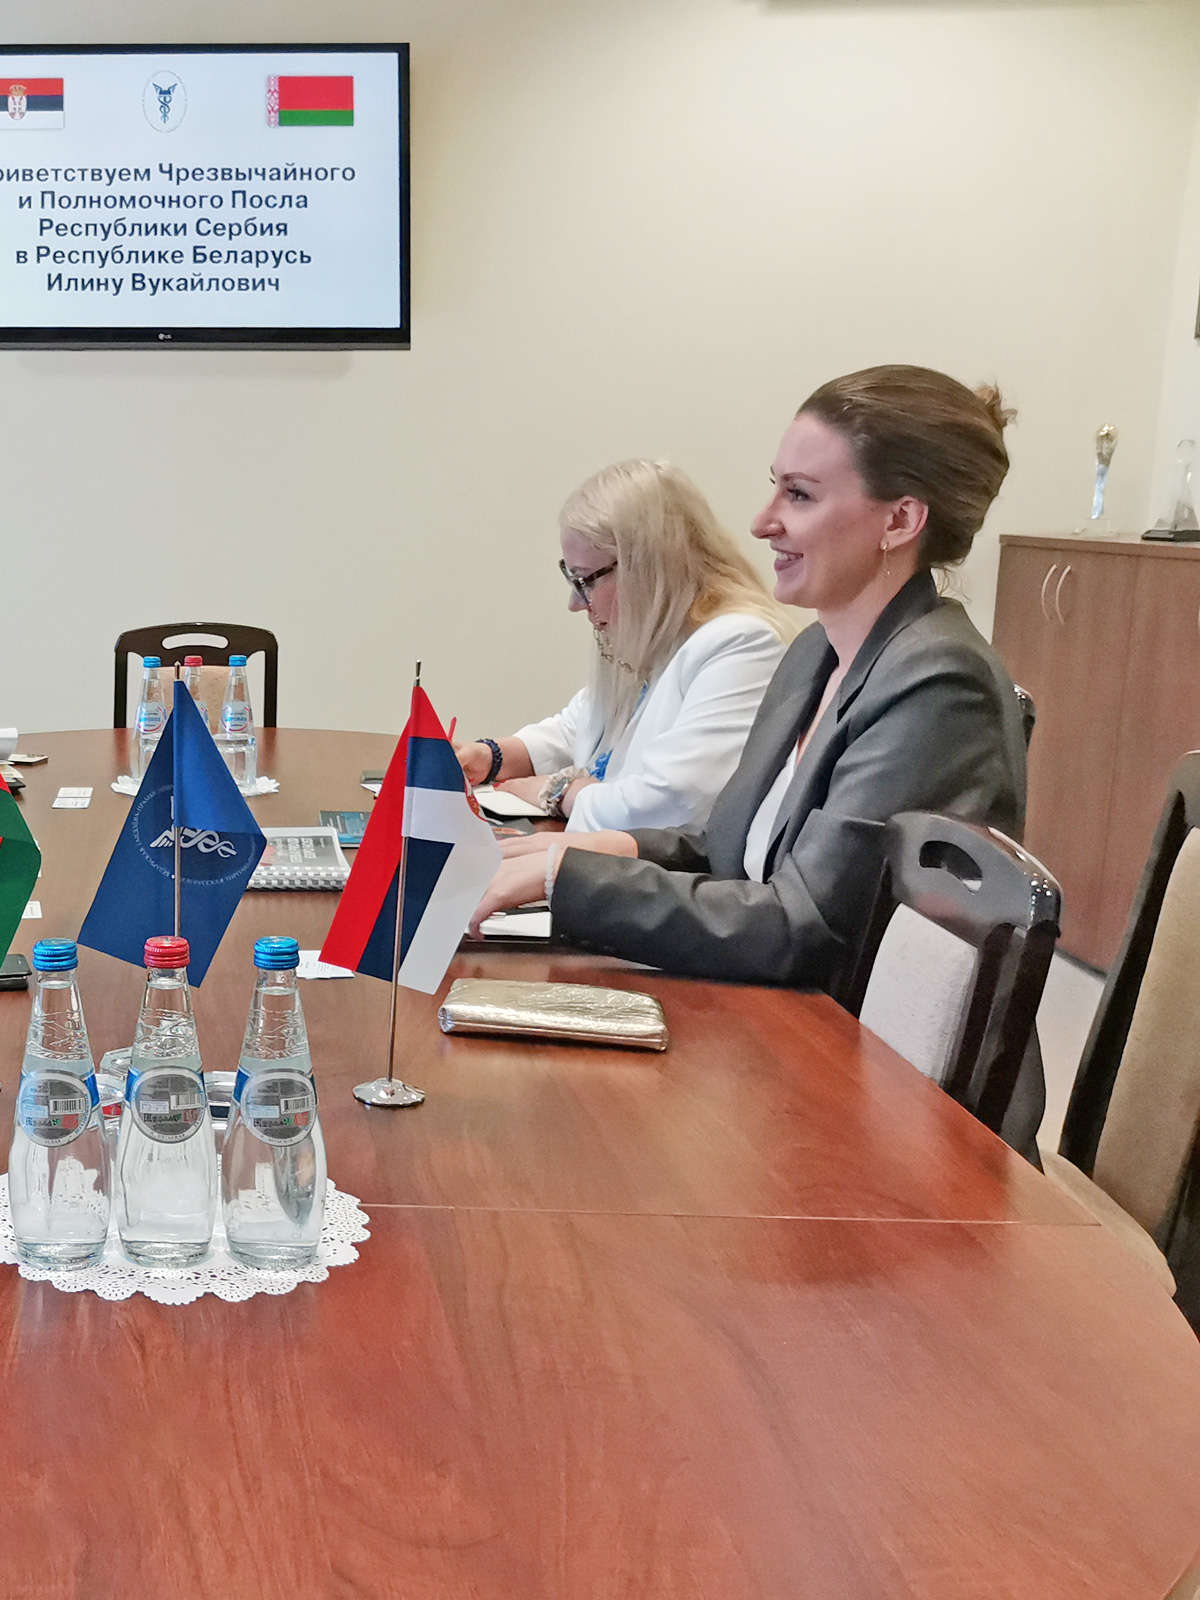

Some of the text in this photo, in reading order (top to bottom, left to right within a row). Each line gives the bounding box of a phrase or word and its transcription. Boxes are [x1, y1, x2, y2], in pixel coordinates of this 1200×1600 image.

[158, 162, 356, 186] Чрезвычайного
[18, 190, 308, 209] и Полномочного Посла
[39, 217, 288, 241] Республики Сербия
[15, 244, 312, 268] в Республике Беларусь
[47, 271, 280, 296] Илину Вукайлович
